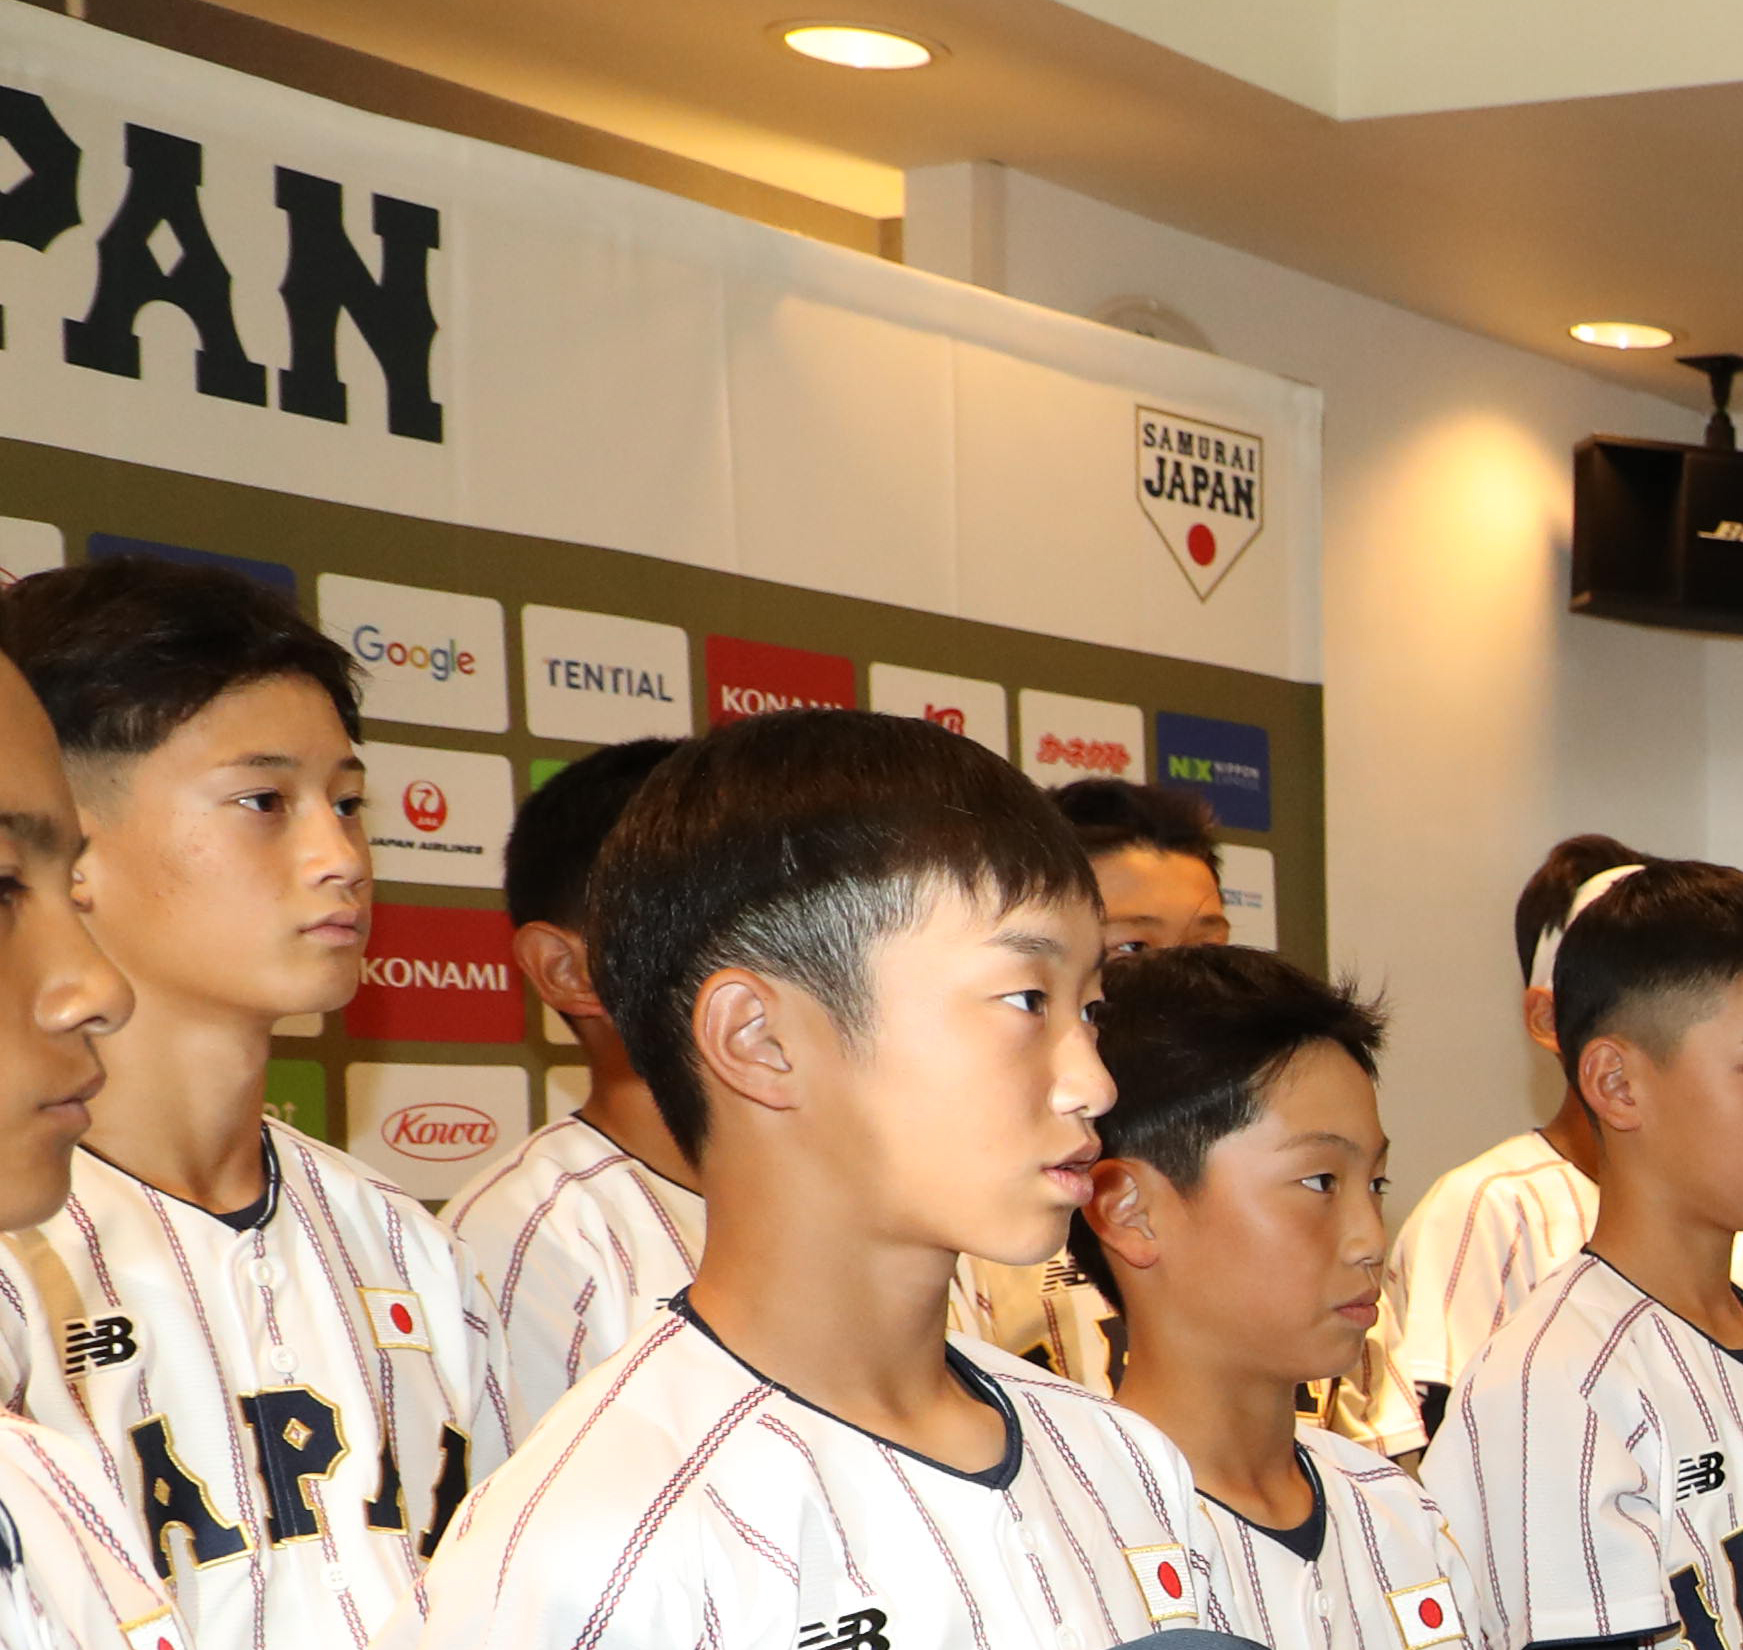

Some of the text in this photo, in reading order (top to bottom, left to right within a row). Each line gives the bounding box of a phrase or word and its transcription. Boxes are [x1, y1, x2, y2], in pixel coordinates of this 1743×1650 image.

[1143, 423, 1254, 472] SAMURAI
[1143, 457, 1254, 520] JAPAN
[353, 625, 476, 682] Google
[543, 658, 675, 702] TENTIAL
[369, 837, 483, 854] JAPAN AIRLINES
[360, 957, 509, 991] KONAMI
[391, 1112, 492, 1146] Kowa
